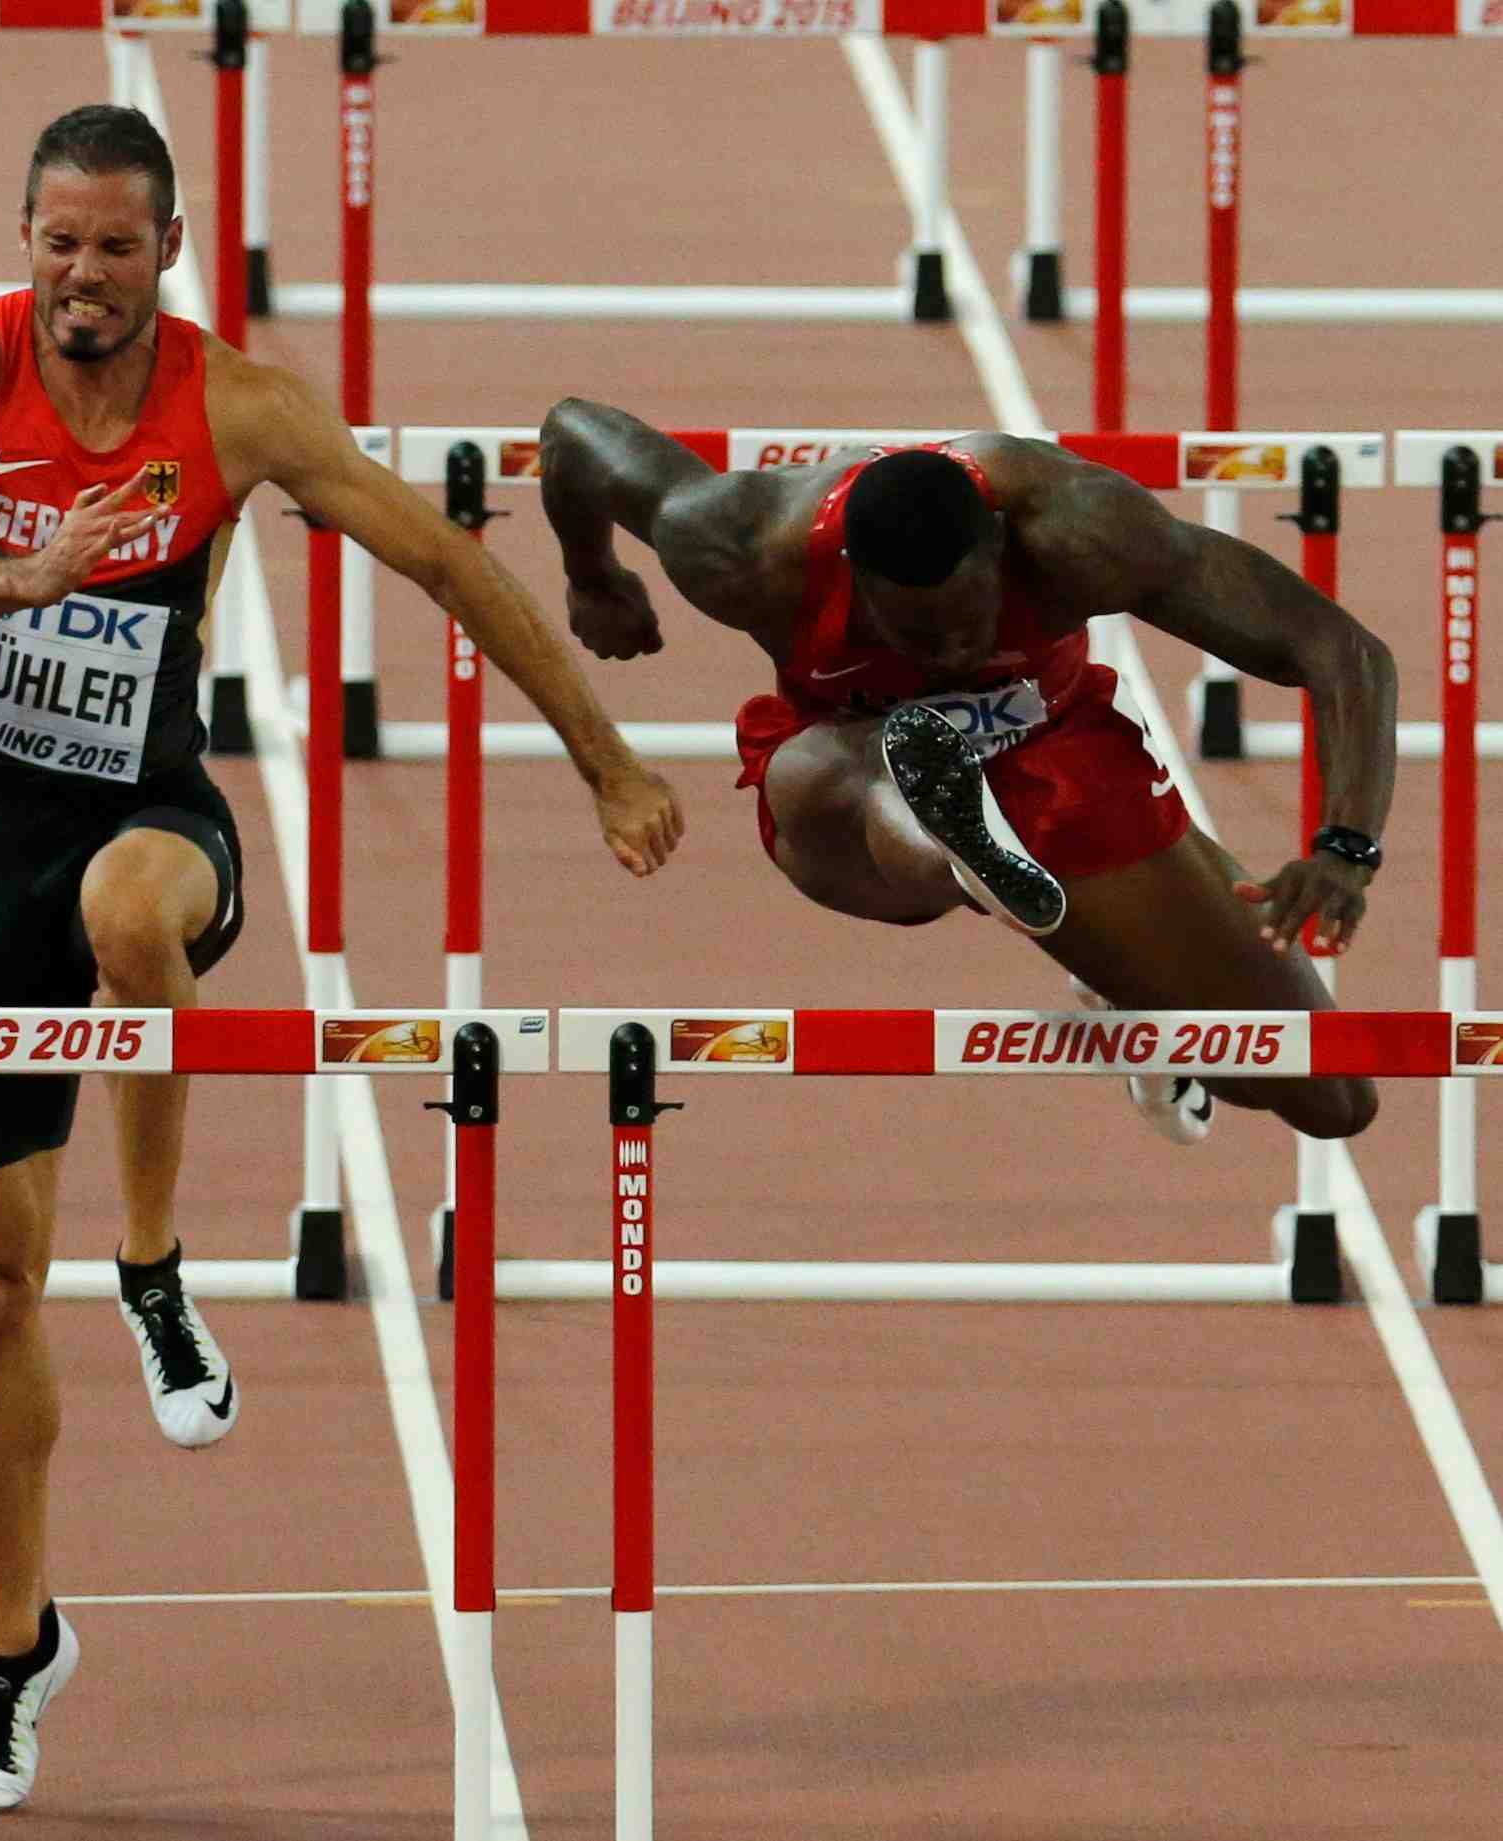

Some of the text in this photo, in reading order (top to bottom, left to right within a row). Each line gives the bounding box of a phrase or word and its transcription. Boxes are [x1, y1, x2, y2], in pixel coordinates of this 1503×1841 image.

[1446, 575, 1474, 685] MONDO
[941, 690, 1028, 735] DK
[59, 742, 131, 775] 2015
[29, 1019, 146, 1061] 2015
[961, 1022, 1285, 1065] BEIJING 2015
[619, 1174, 647, 1296] MONDO
